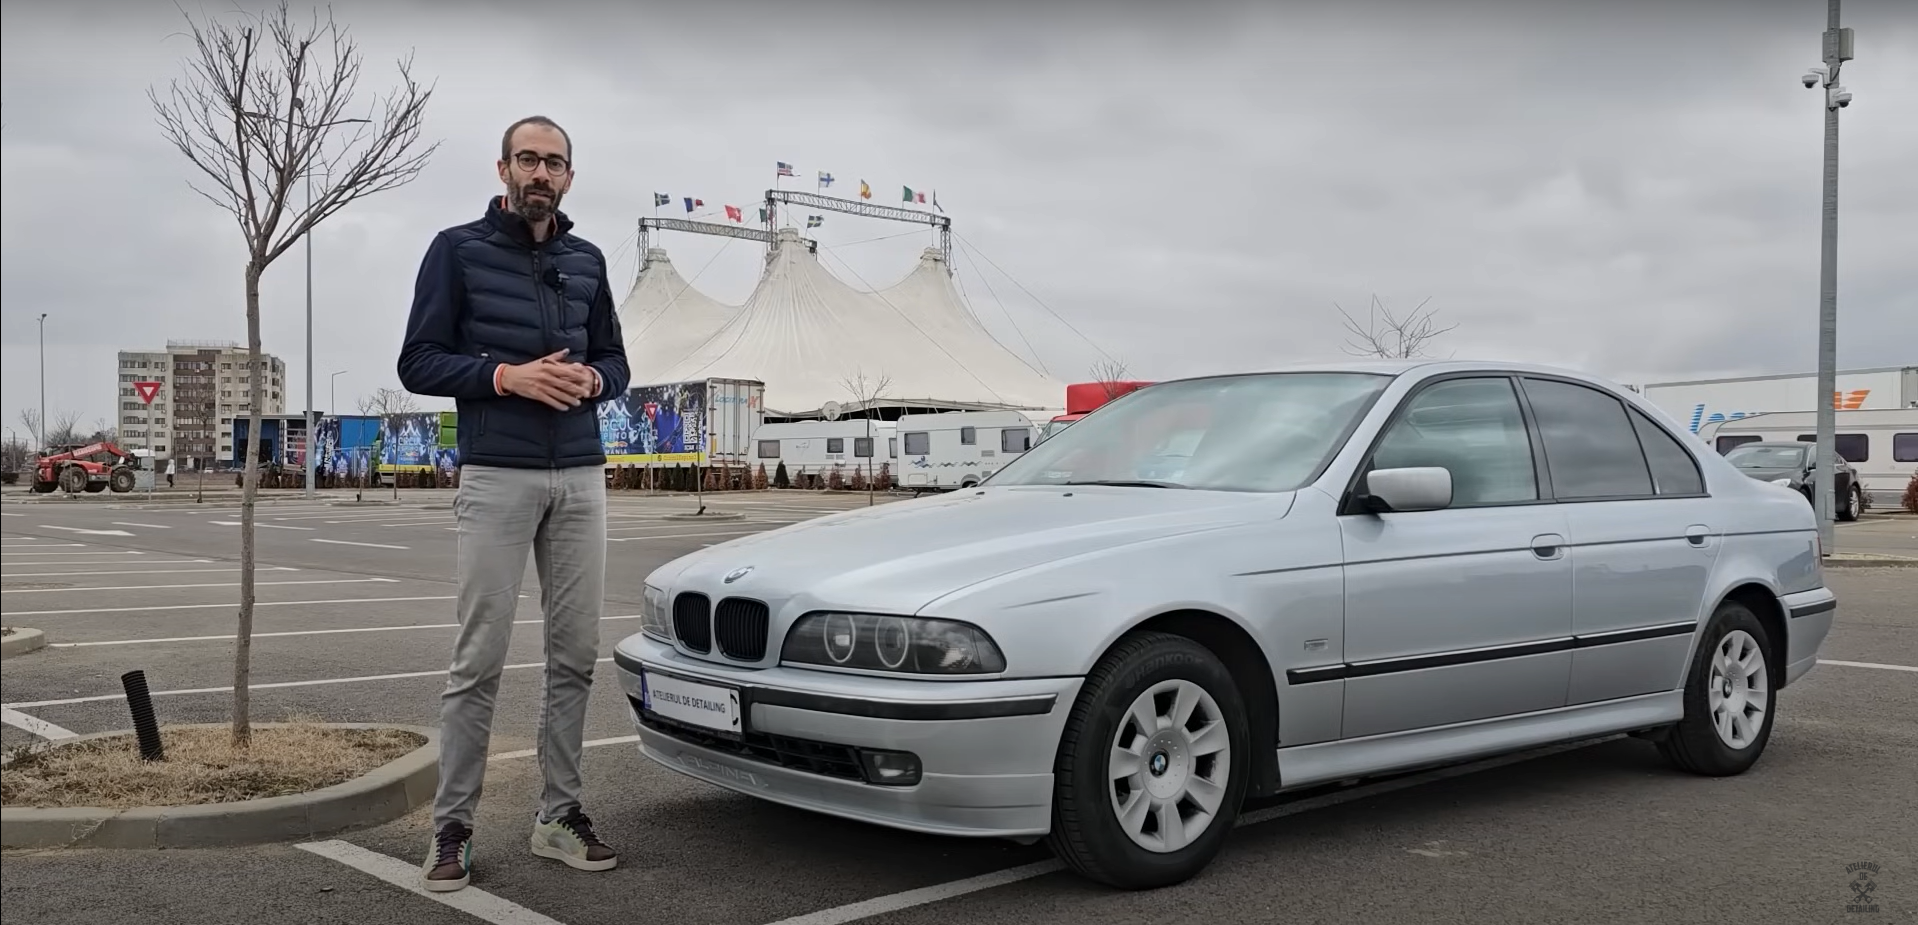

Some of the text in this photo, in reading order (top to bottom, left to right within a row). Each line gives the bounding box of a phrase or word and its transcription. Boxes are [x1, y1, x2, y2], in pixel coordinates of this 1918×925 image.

[598, 417, 633, 431] IRCUL
[652, 689, 726, 713] ATELIERUL DE DETAILING
